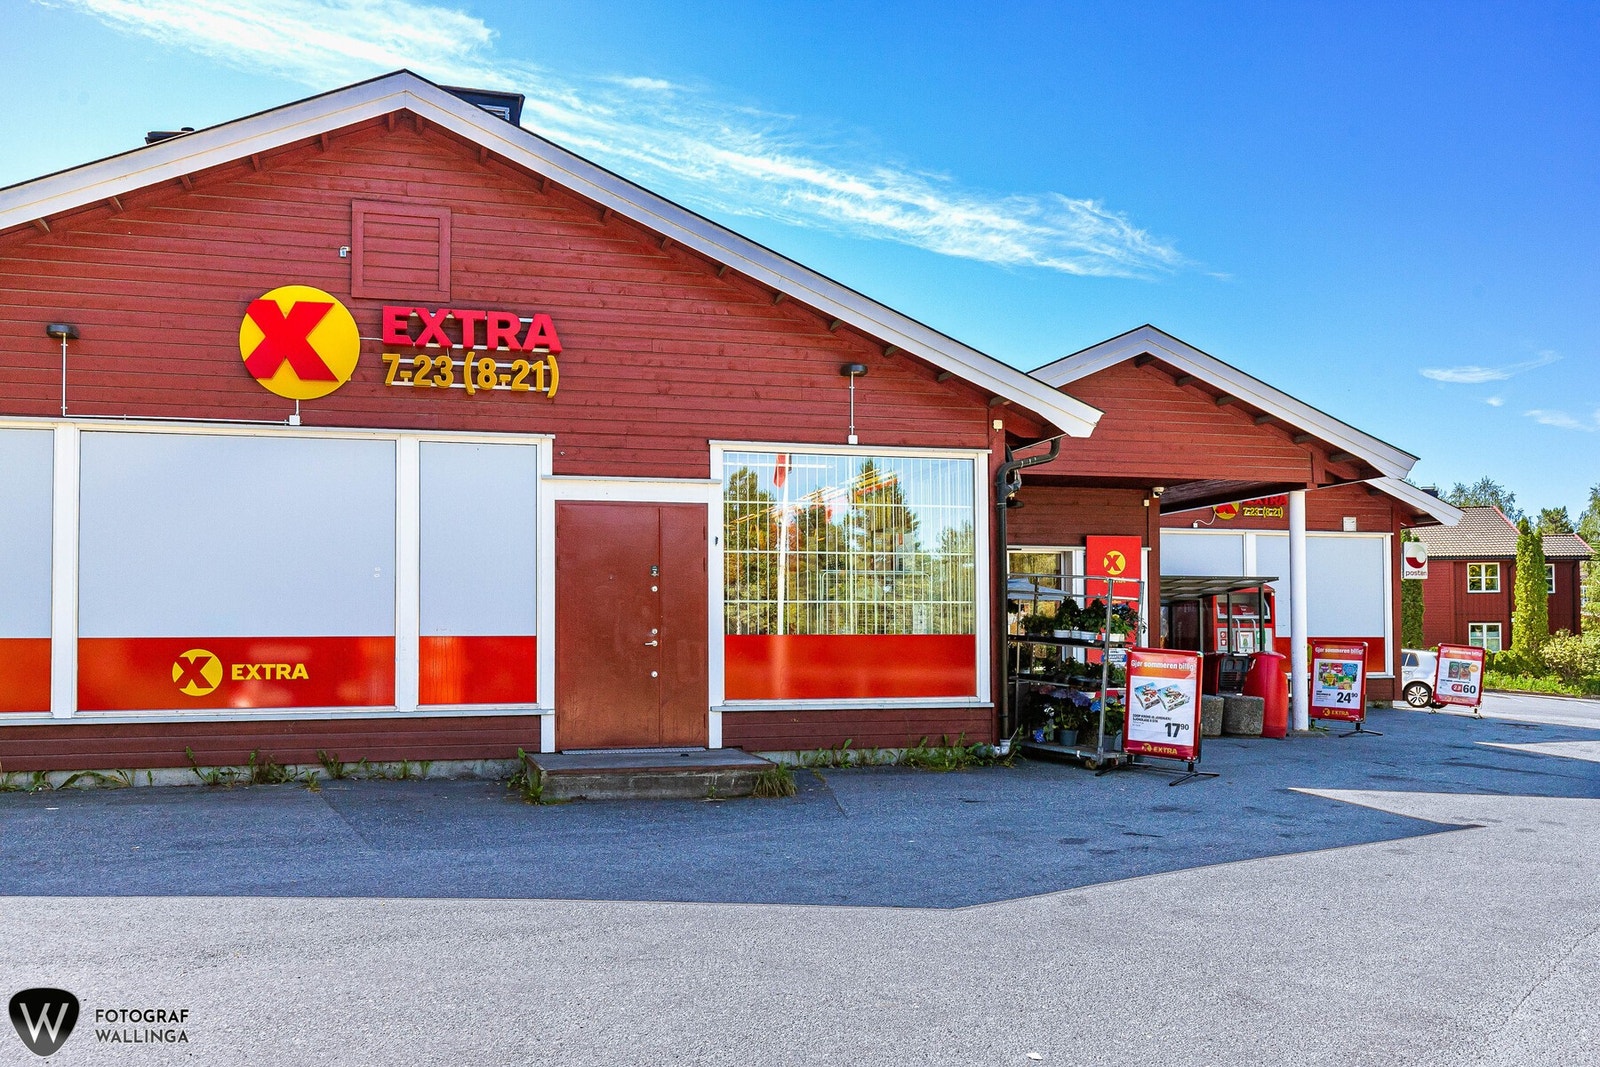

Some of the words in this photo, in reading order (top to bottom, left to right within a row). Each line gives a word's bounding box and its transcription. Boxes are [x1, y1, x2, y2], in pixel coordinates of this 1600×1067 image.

[382, 305, 563, 353] EXTRA
[382, 353, 454, 388] 7-23
[463, 351, 560, 398] (8-21)
[231, 663, 309, 681] EXTRA
[1462, 684, 1477, 694] 60
[1153, 746, 1178, 755] EXTRA
